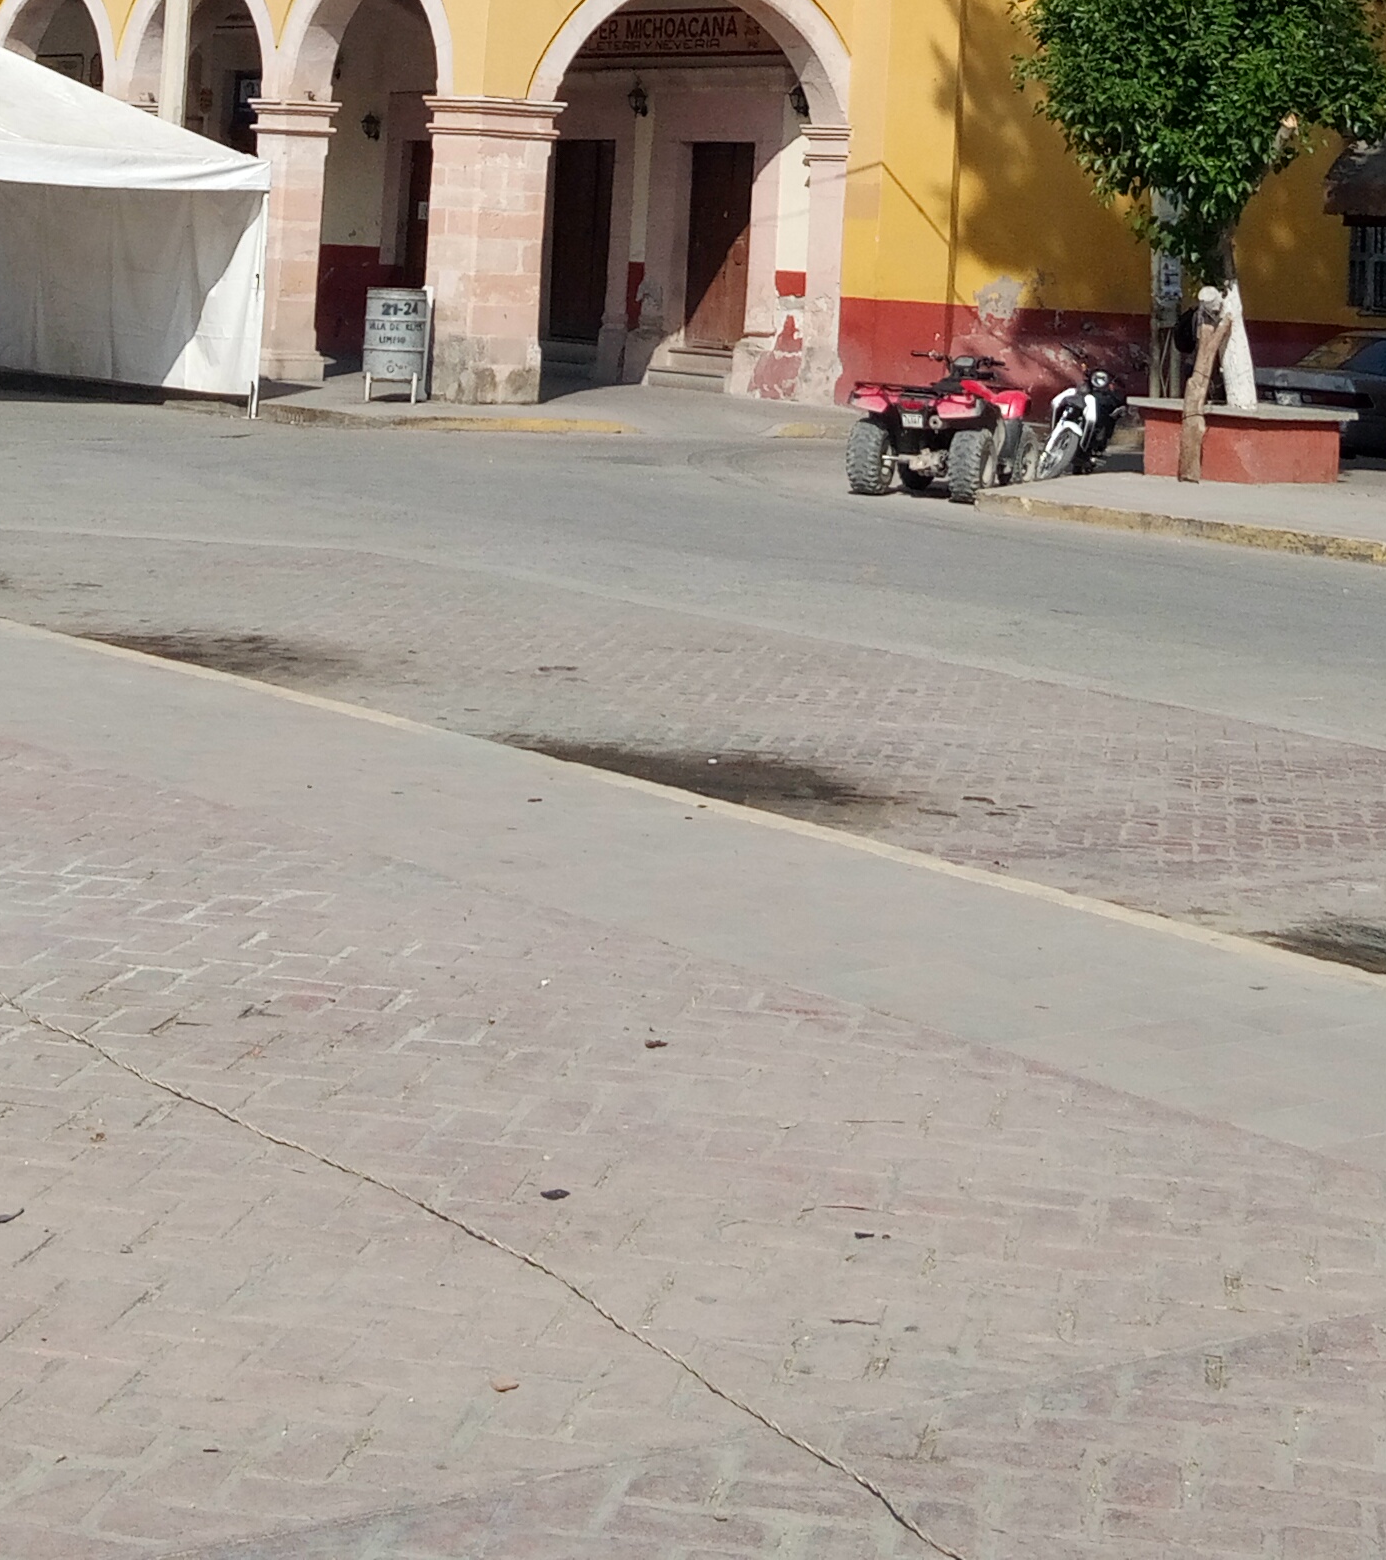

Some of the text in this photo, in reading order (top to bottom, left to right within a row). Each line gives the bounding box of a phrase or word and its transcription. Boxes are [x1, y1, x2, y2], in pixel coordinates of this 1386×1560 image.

[626, 15, 738, 39] MICHOACANA
[644, 40, 653, 50] Y
[656, 38, 721, 50] NEVERIA
